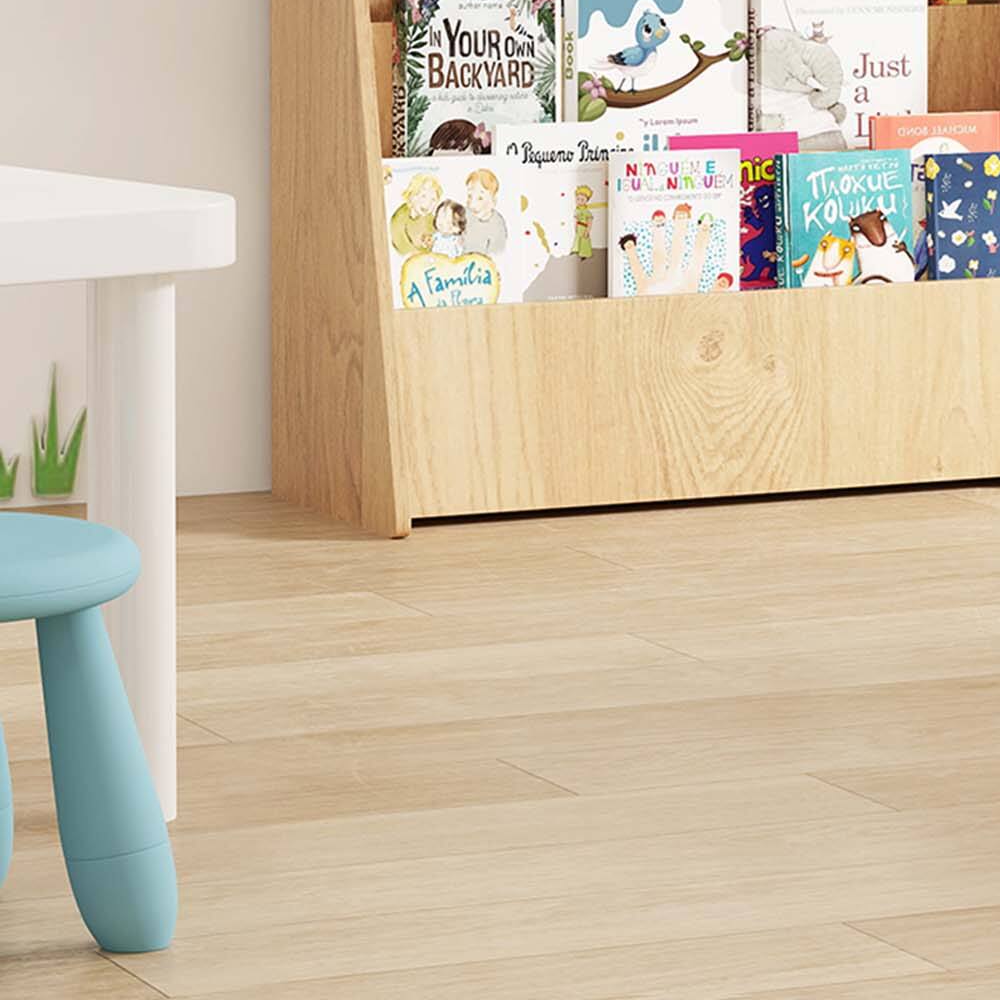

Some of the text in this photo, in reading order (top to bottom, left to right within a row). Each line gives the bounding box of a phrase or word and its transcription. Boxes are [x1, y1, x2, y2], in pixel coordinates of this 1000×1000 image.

[429, 18, 535, 60] IN YOUR OWN
[427, 53, 535, 90] BACKYARD
[852, 53, 912, 80] Just
[854, 86, 870, 105] a
[521, 141, 575, 168] Pequeno
[425, 261, 492, 294] Família
